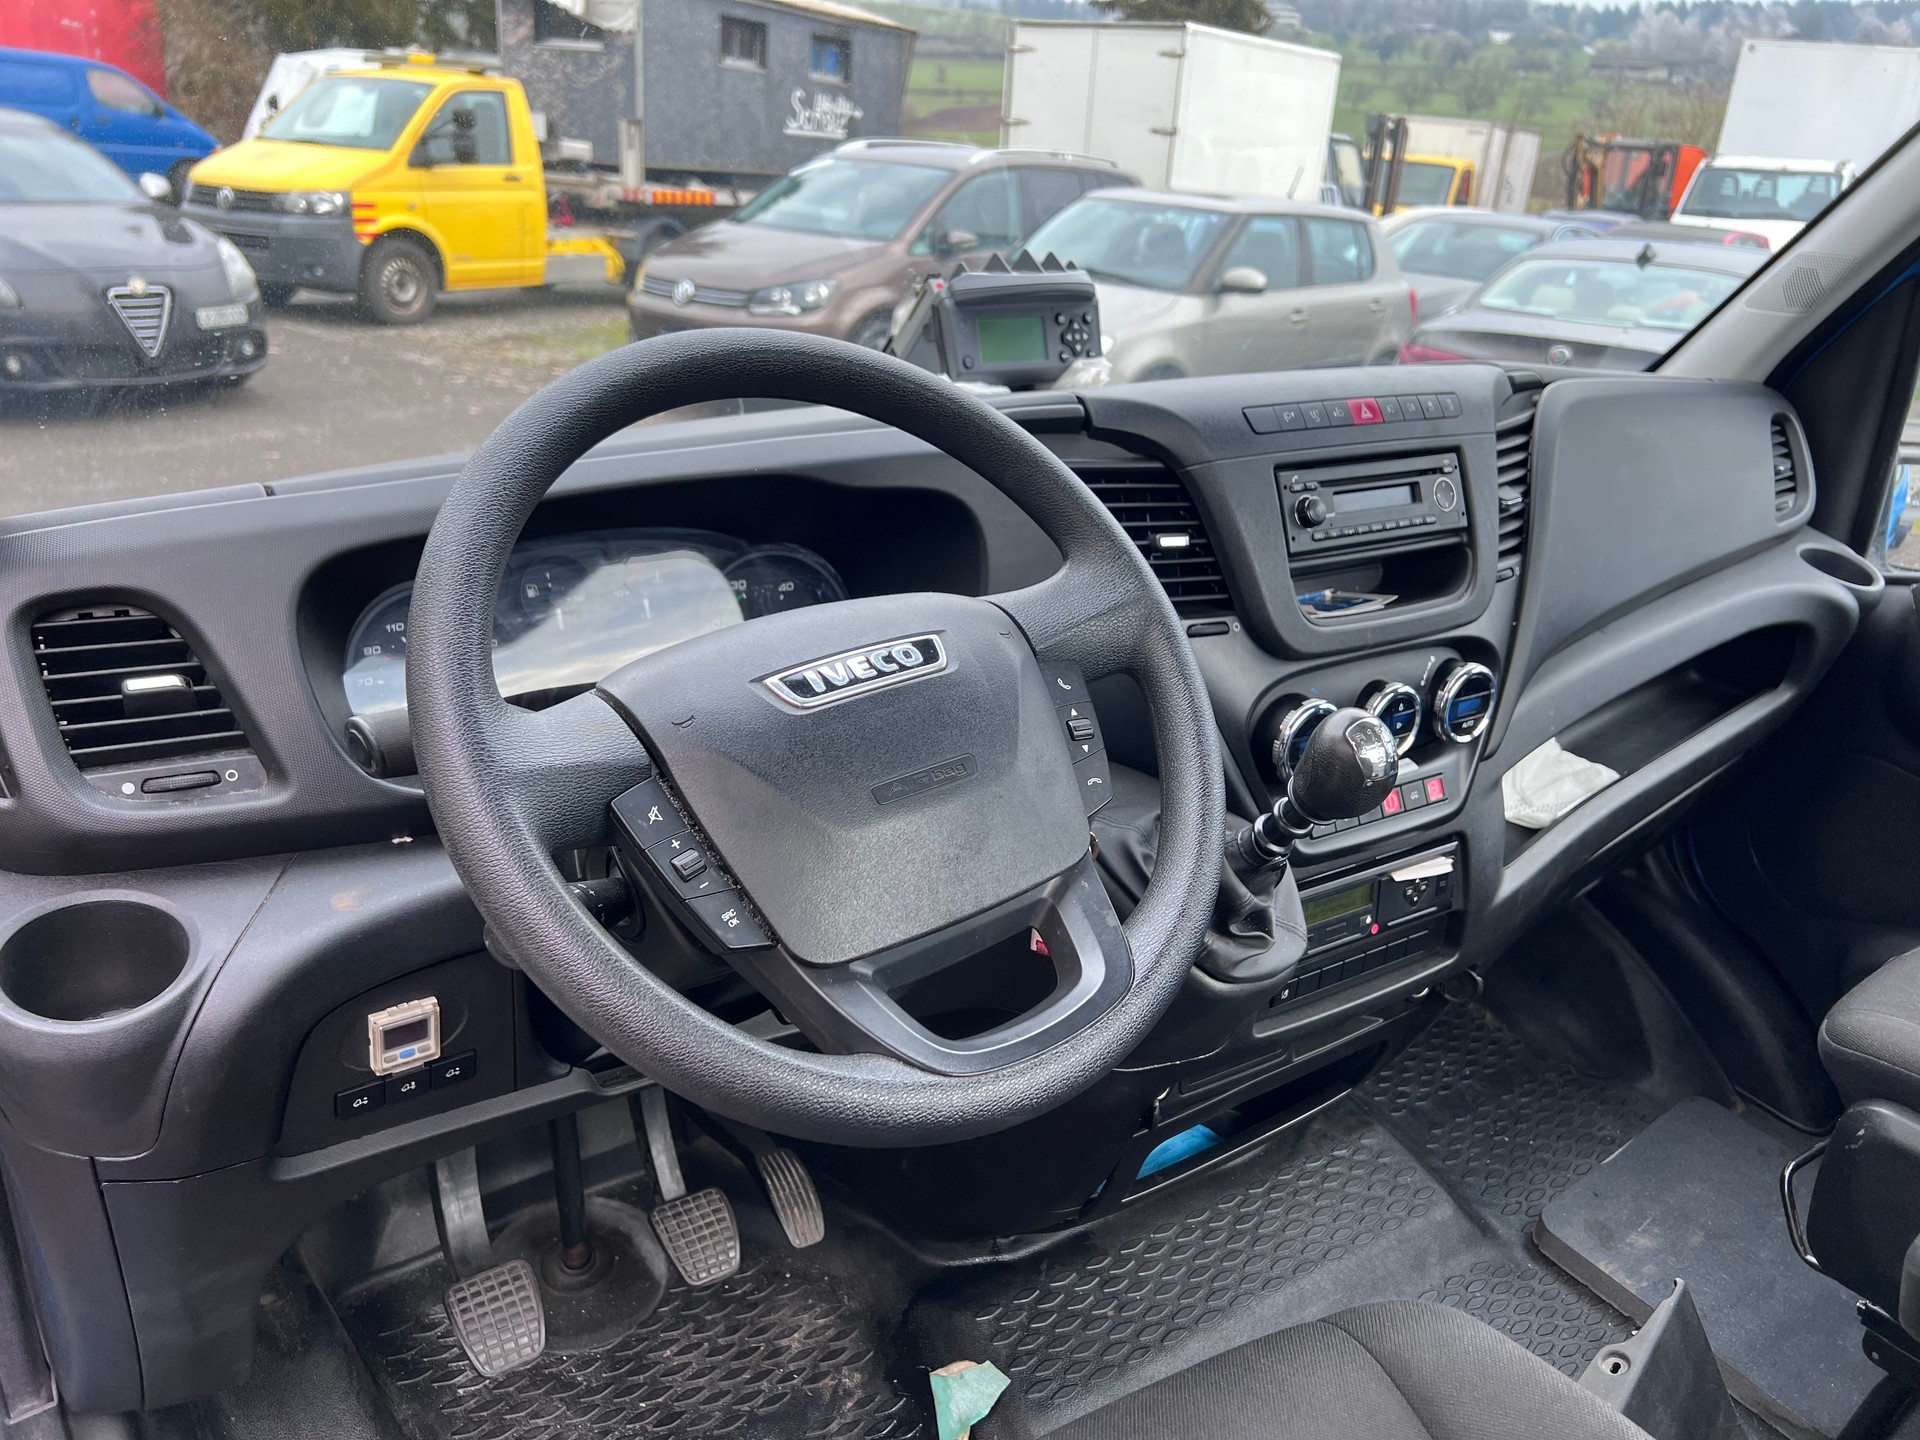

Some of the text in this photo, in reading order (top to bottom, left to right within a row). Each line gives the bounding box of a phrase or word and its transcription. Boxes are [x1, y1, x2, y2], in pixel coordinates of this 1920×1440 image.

[778, 581, 794, 592] 40
[385, 622, 405, 633] 110
[802, 643, 924, 693] IVECO
[356, 677, 373, 687] 70
[728, 916, 741, 928] OK
